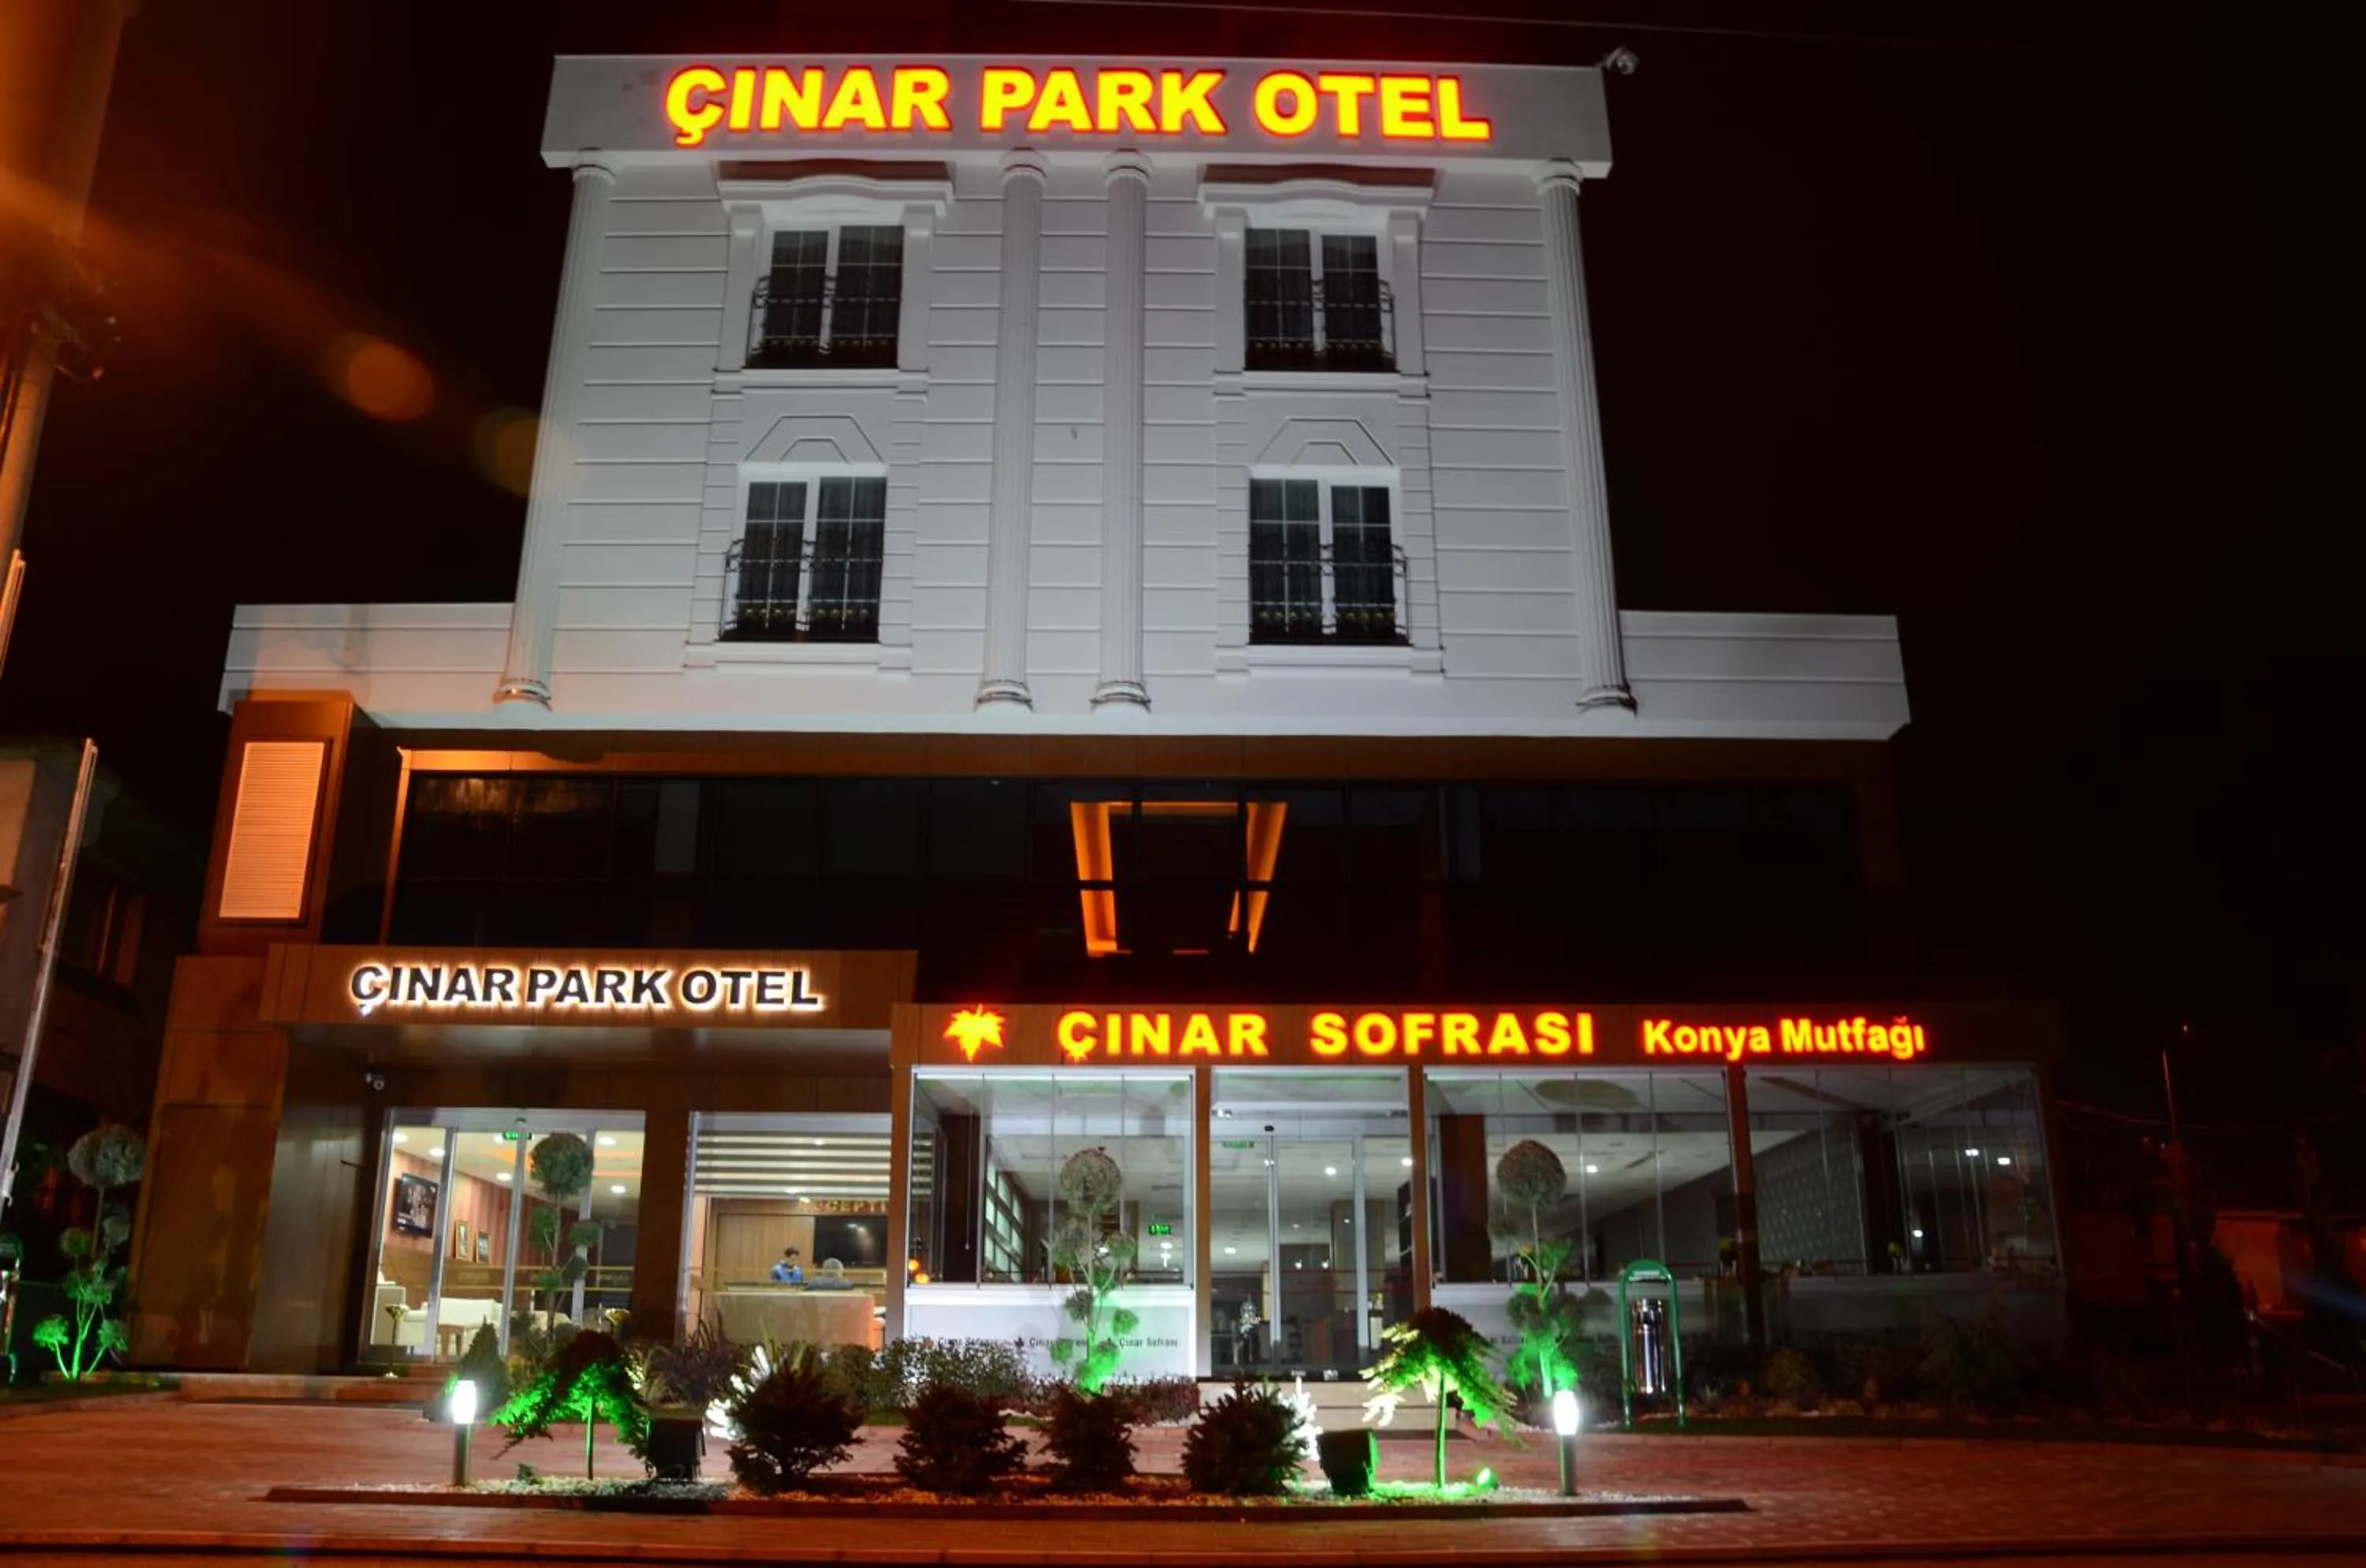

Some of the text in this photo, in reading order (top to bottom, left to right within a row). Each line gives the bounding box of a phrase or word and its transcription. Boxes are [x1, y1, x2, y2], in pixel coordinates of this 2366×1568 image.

[665, 68, 1491, 145] ÇINAR PARK OTEL
[350, 965, 819, 1016] ÇINAR PARK OTEL
[1057, 1011, 1925, 1062] ÇINAR SOFRASI Konya Mutfağı
